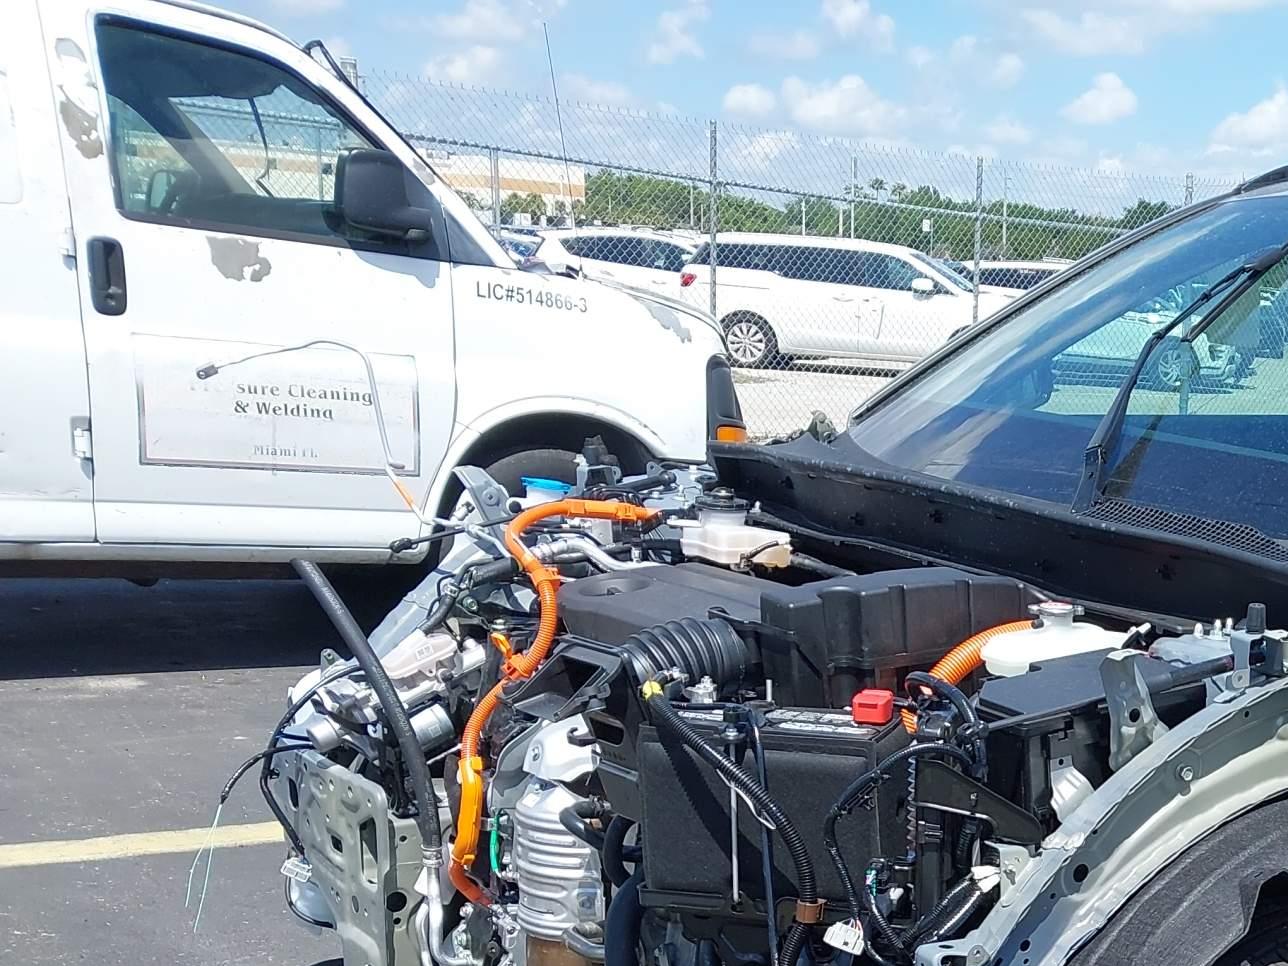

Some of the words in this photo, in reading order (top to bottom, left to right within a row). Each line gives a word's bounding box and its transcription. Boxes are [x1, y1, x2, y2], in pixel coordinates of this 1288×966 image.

[476, 280, 588, 313] LIC#514866-3
[287, 384, 373, 406] Cleaning
[233, 400, 249, 414] &
[253, 444, 297, 457] Miami
